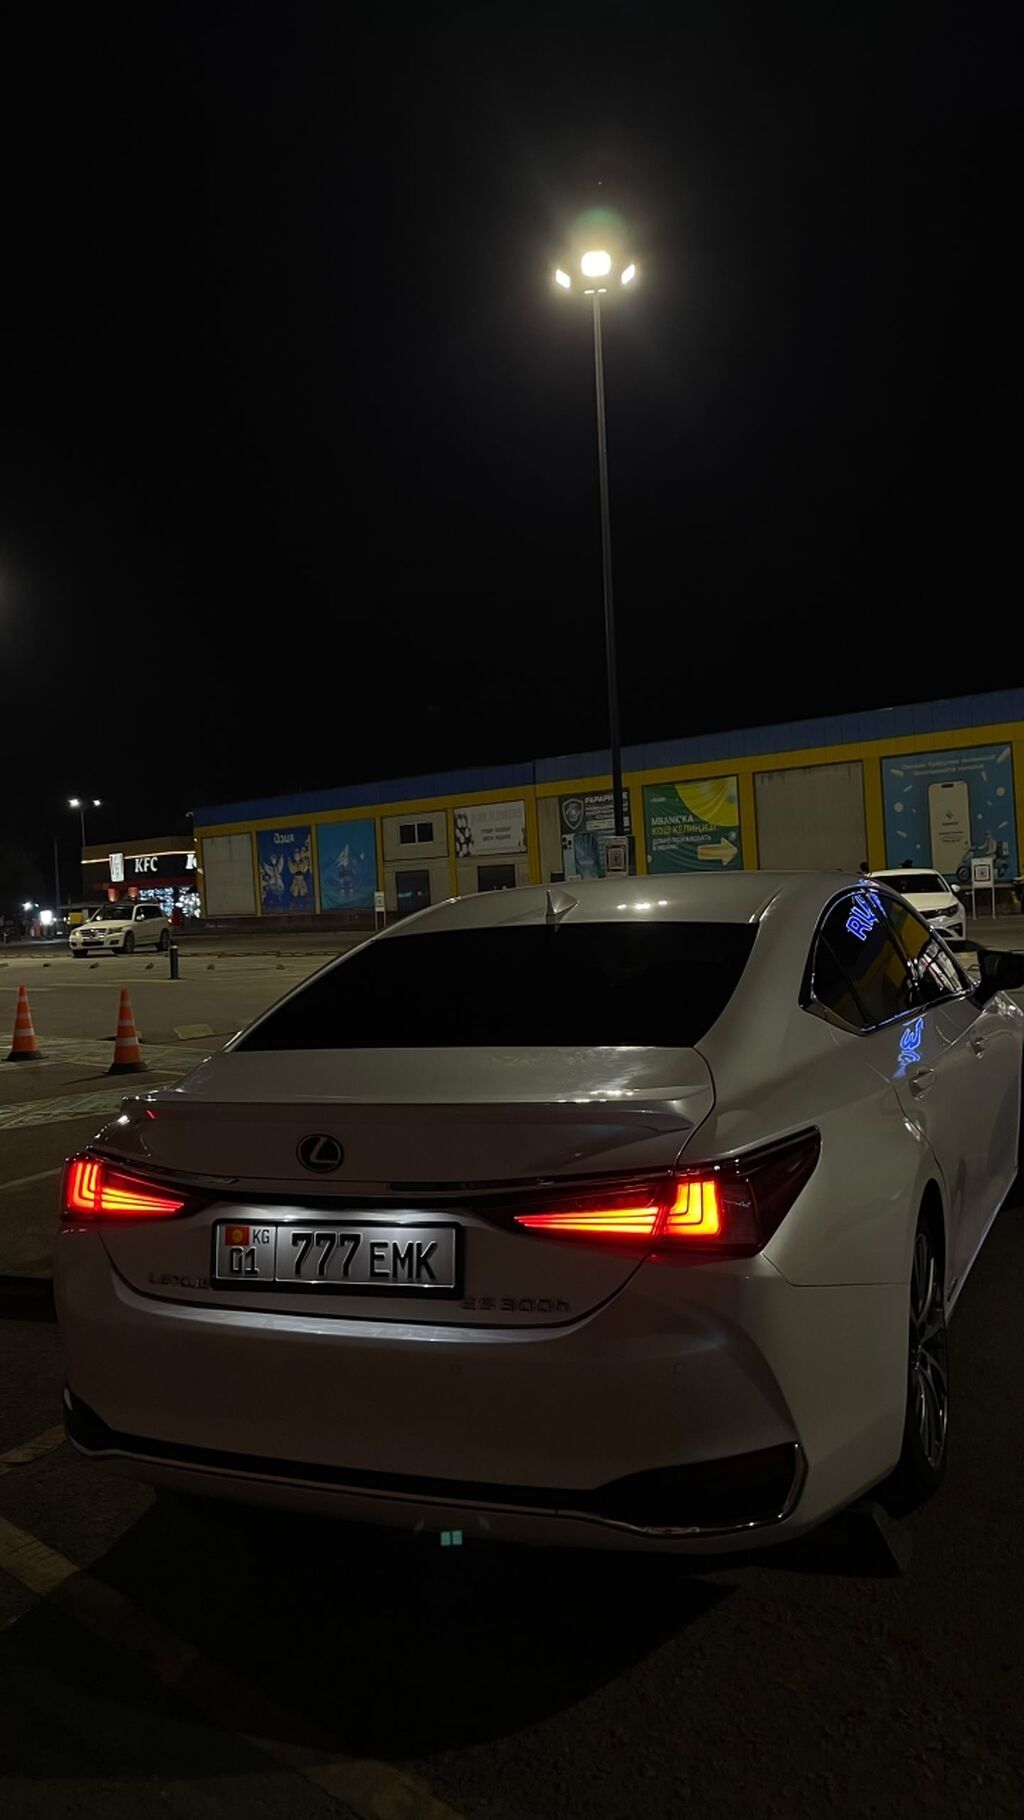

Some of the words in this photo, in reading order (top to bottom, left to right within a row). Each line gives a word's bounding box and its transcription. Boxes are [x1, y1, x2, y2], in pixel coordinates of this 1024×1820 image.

[134, 856, 158, 873] KFC
[252, 1229, 269, 1244] KG
[230, 1245, 259, 1274] 01
[291, 1230, 361, 1280] 777
[369, 1241, 437, 1280] EMK
